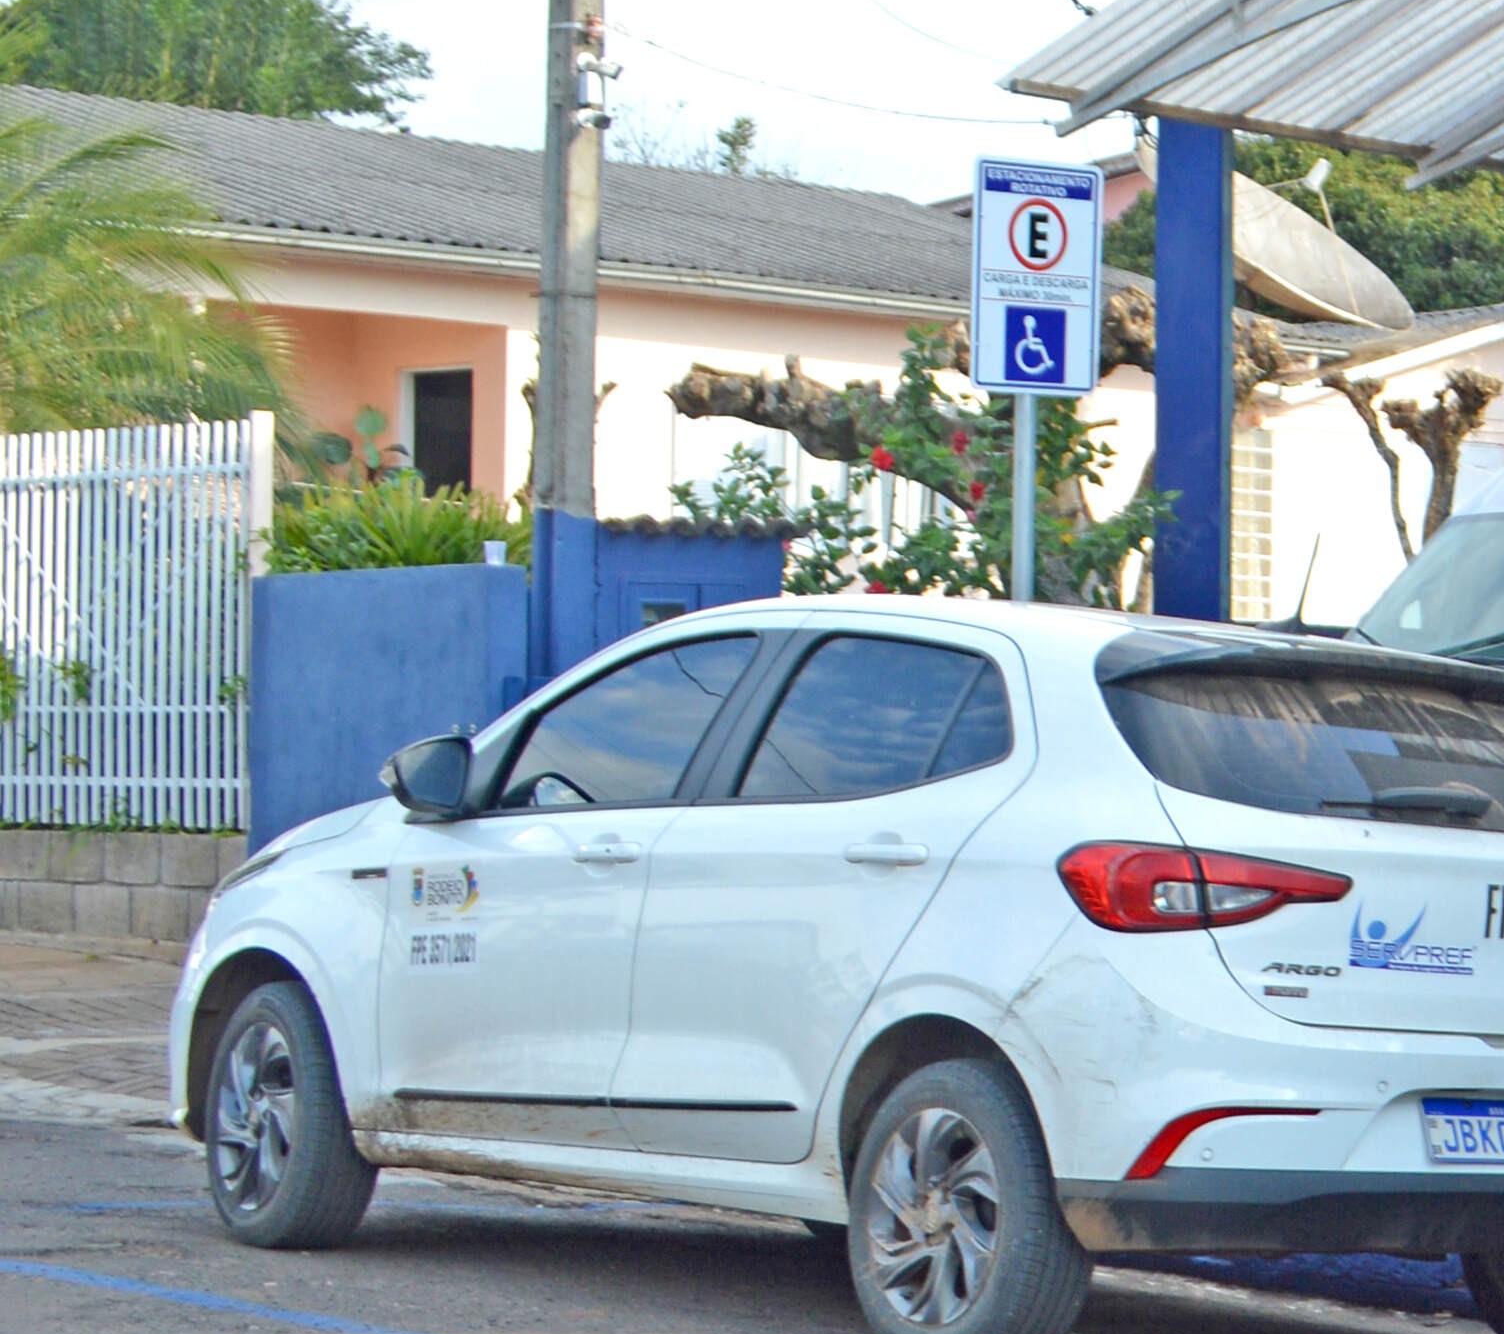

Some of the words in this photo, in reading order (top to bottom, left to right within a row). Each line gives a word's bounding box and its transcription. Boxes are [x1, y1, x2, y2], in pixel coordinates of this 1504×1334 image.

[986, 167, 1091, 189] ESTACIONAMENTO
[1010, 181, 1068, 197] ROTATIVO
[1028, 212, 1050, 260] E
[983, 271, 1021, 285] CARGA
[1022, 274, 1031, 286] E
[1031, 275, 1089, 290] DESCARGA
[1260, 961, 1343, 977] ARGO
